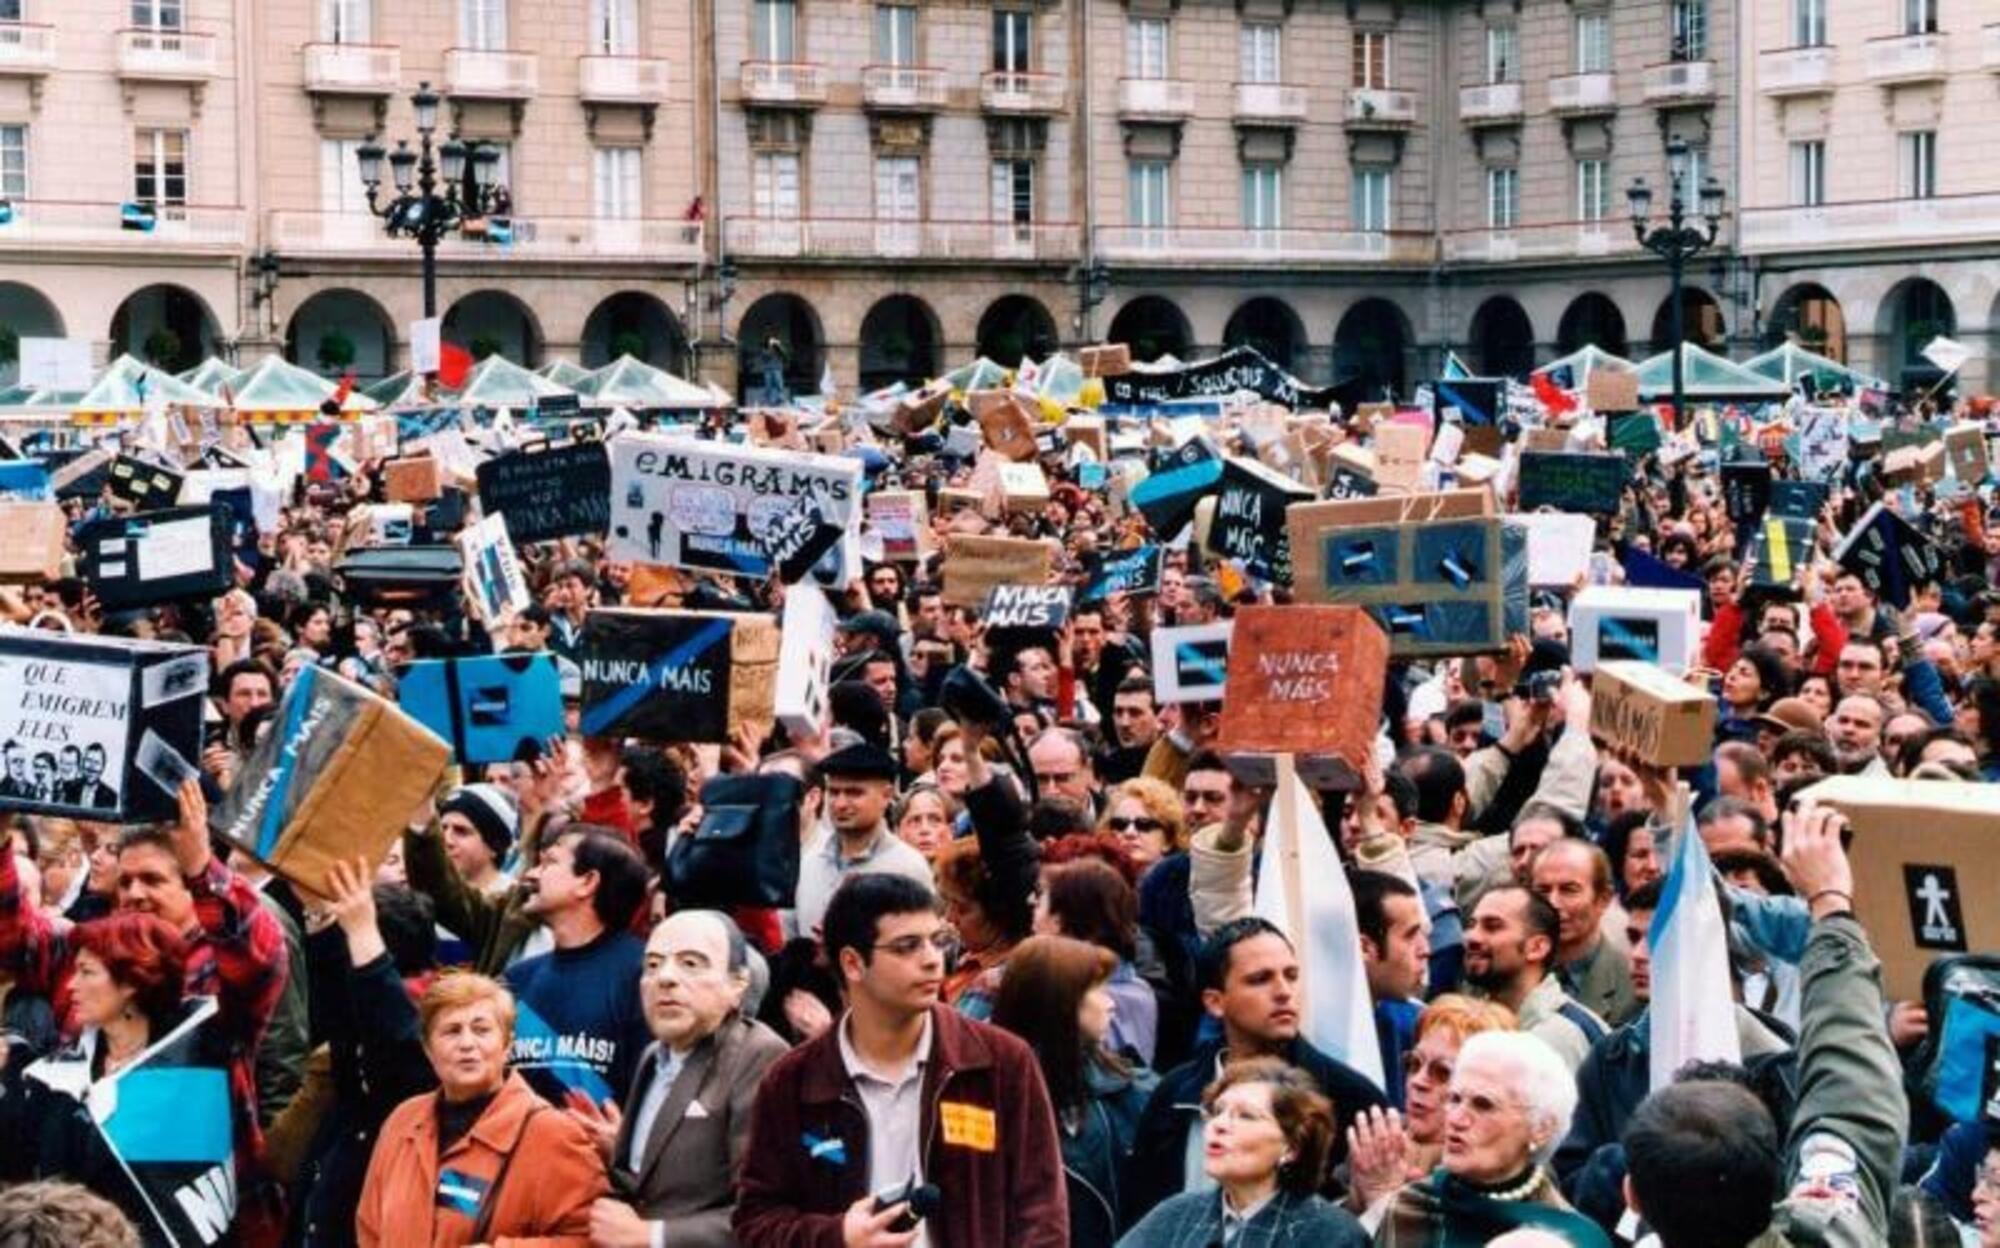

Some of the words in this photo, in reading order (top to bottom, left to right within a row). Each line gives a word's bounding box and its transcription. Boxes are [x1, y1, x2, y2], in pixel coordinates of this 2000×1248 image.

[991, 584, 1070, 606] NUNCA
[24, 662, 69, 687] QUE
[584, 658, 651, 686] NUNCA
[1258, 652, 1339, 676] NUNCA
[20, 690, 127, 722] EMIGREM
[16, 719, 72, 743] ELES
[228, 767, 284, 839] NUNCA
[556, 1030, 616, 1063] MÁIS!
